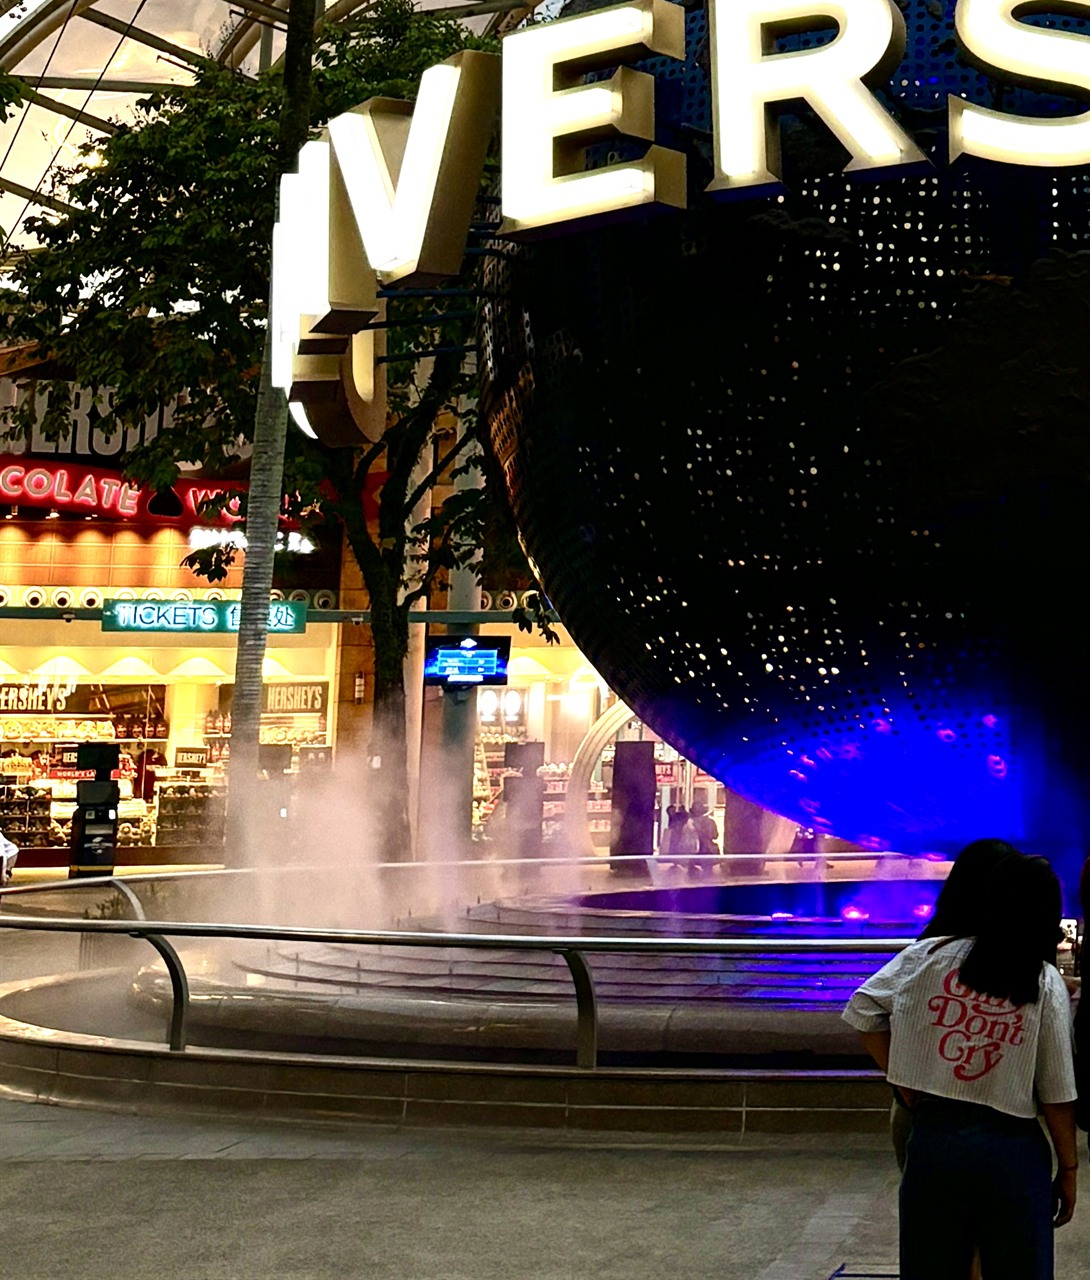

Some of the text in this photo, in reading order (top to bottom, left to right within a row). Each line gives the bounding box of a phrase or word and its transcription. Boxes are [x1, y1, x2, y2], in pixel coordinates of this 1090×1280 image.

[119, 606, 216, 626] TICKETS
[267, 686, 322, 710] HERSHEY'S
[928, 995, 1026, 1046] Don't
[938, 1030, 1004, 1081] Cry
